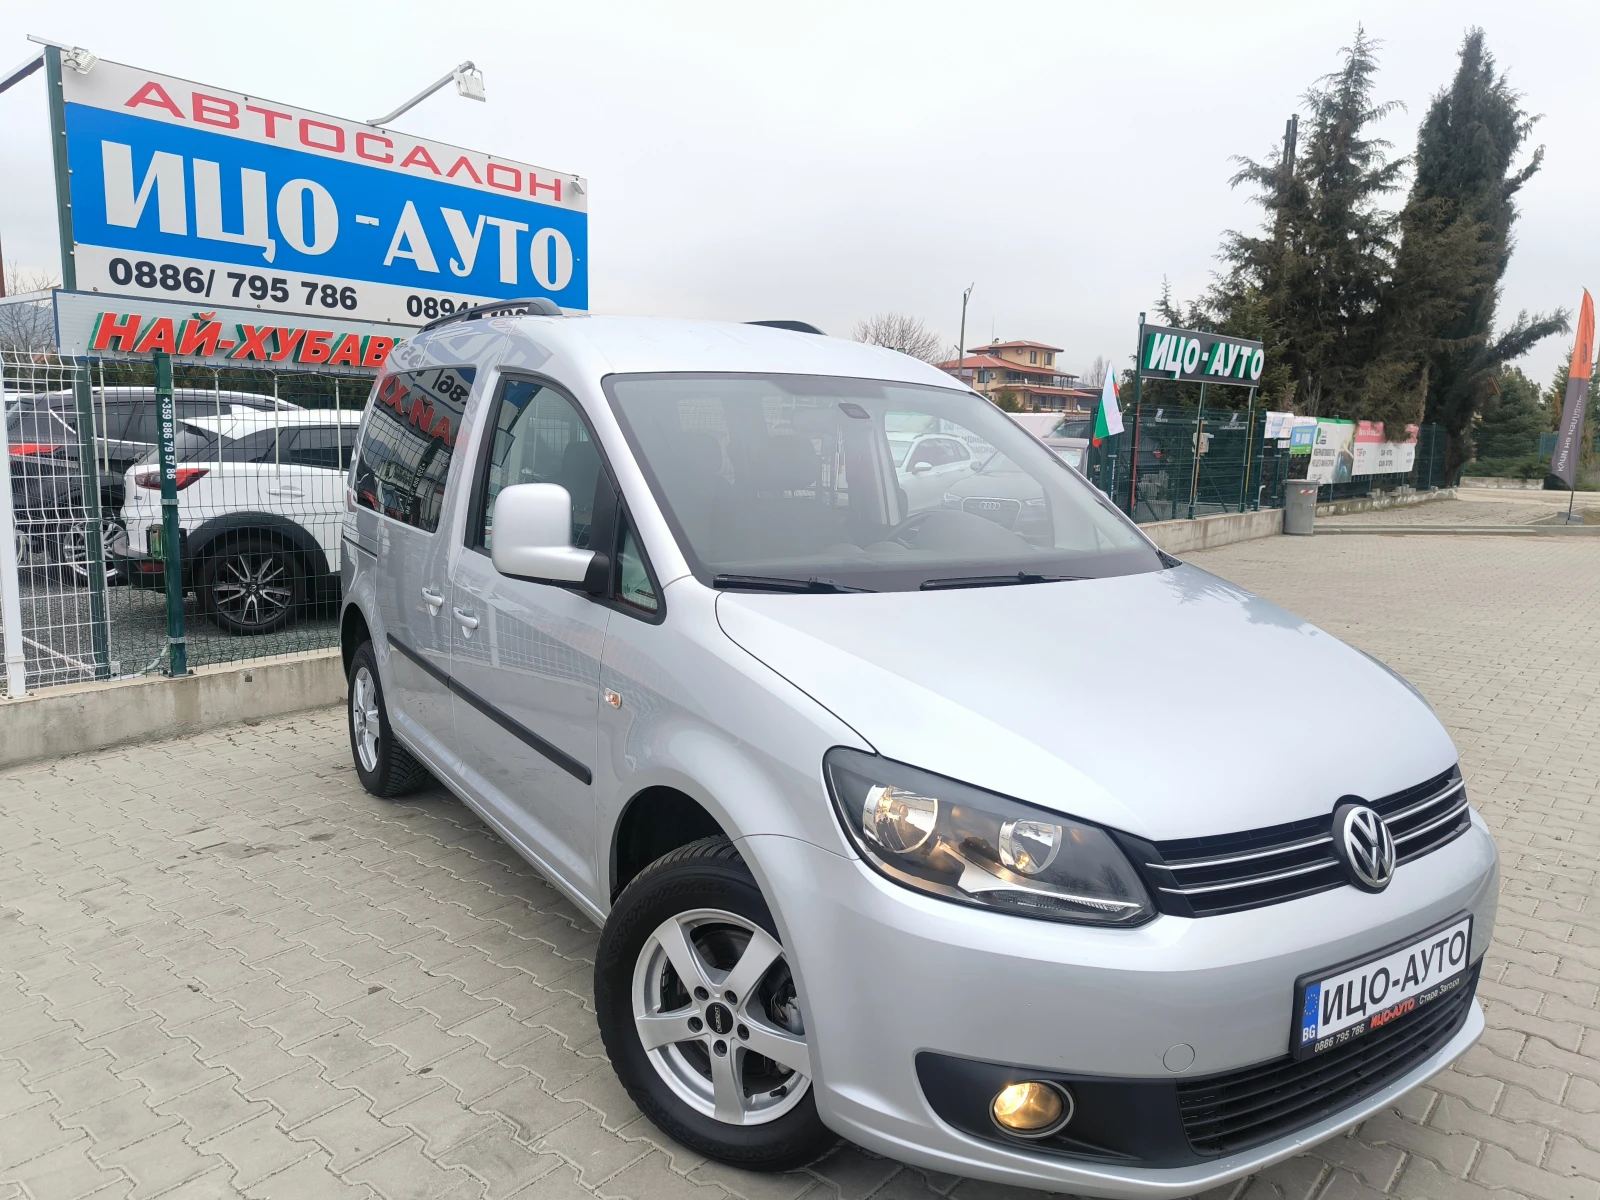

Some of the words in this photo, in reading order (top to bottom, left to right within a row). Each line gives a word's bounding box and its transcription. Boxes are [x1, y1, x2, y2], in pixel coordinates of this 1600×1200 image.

[124, 80, 562, 202] АВТОСАЛОН
[108, 257, 216, 298] 0886/
[226, 271, 290, 303] 795
[300, 281, 358, 311] 786
[90, 311, 403, 368] НАЙ-ХУБАВ
[1147, 332, 1265, 382] ИЦО-АУТО
[161, 396, 172, 420] +359
[162, 421, 173, 439] 886
[164, 441, 174, 452] 79
[165, 455, 176, 466] 57
[166, 467, 176, 480] 86
[1322, 930, 1466, 1027] ИЦО-АУТО
[1370, 997, 1416, 1029] ИЦО-АУТО
[1302, 1024, 1316, 1042] BG
[1314, 1036, 1334, 1053] 0886
[1335, 1030, 1350, 1044] 795
[1351, 1023, 1365, 1037] 786
